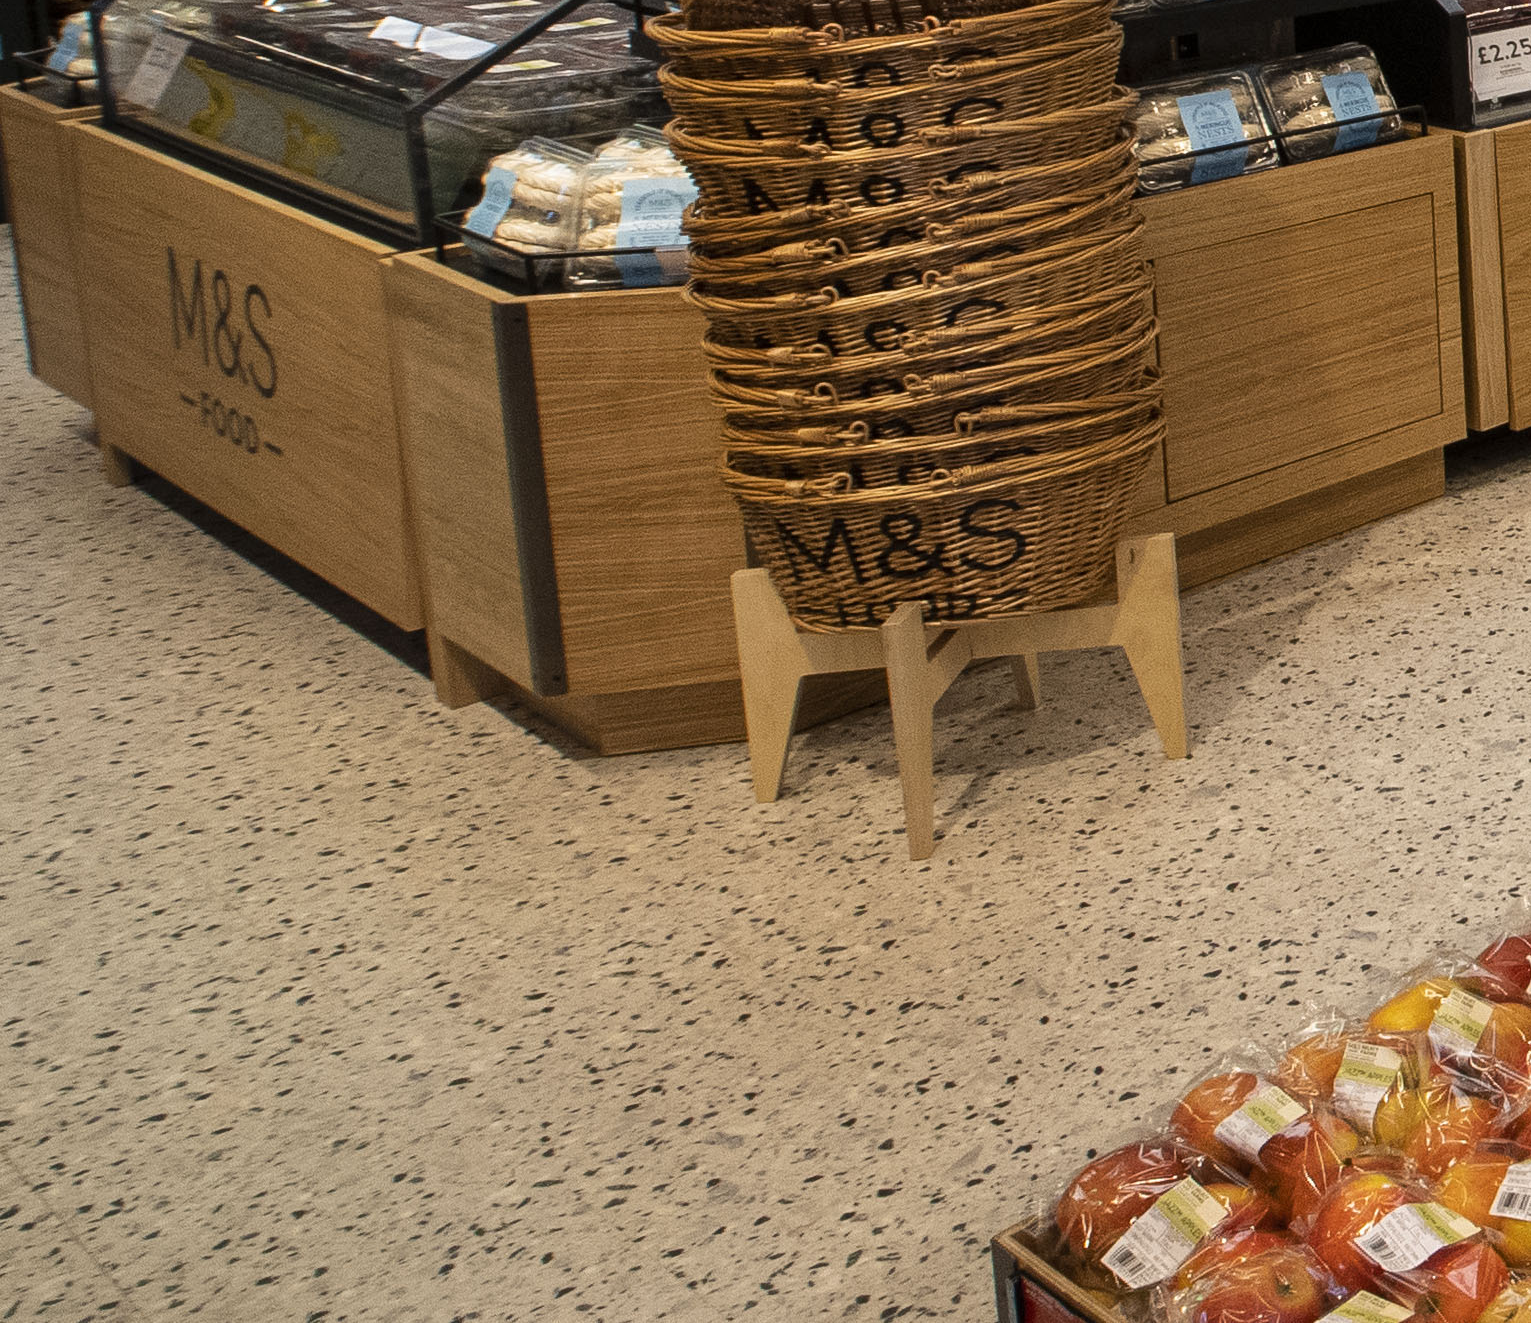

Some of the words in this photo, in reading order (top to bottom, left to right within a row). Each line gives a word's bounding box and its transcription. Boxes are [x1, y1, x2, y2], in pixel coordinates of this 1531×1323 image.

[166, 246, 278, 399] M&S
[199, 396, 260, 457] FOOD
[776, 498, 1026, 585] M&S
